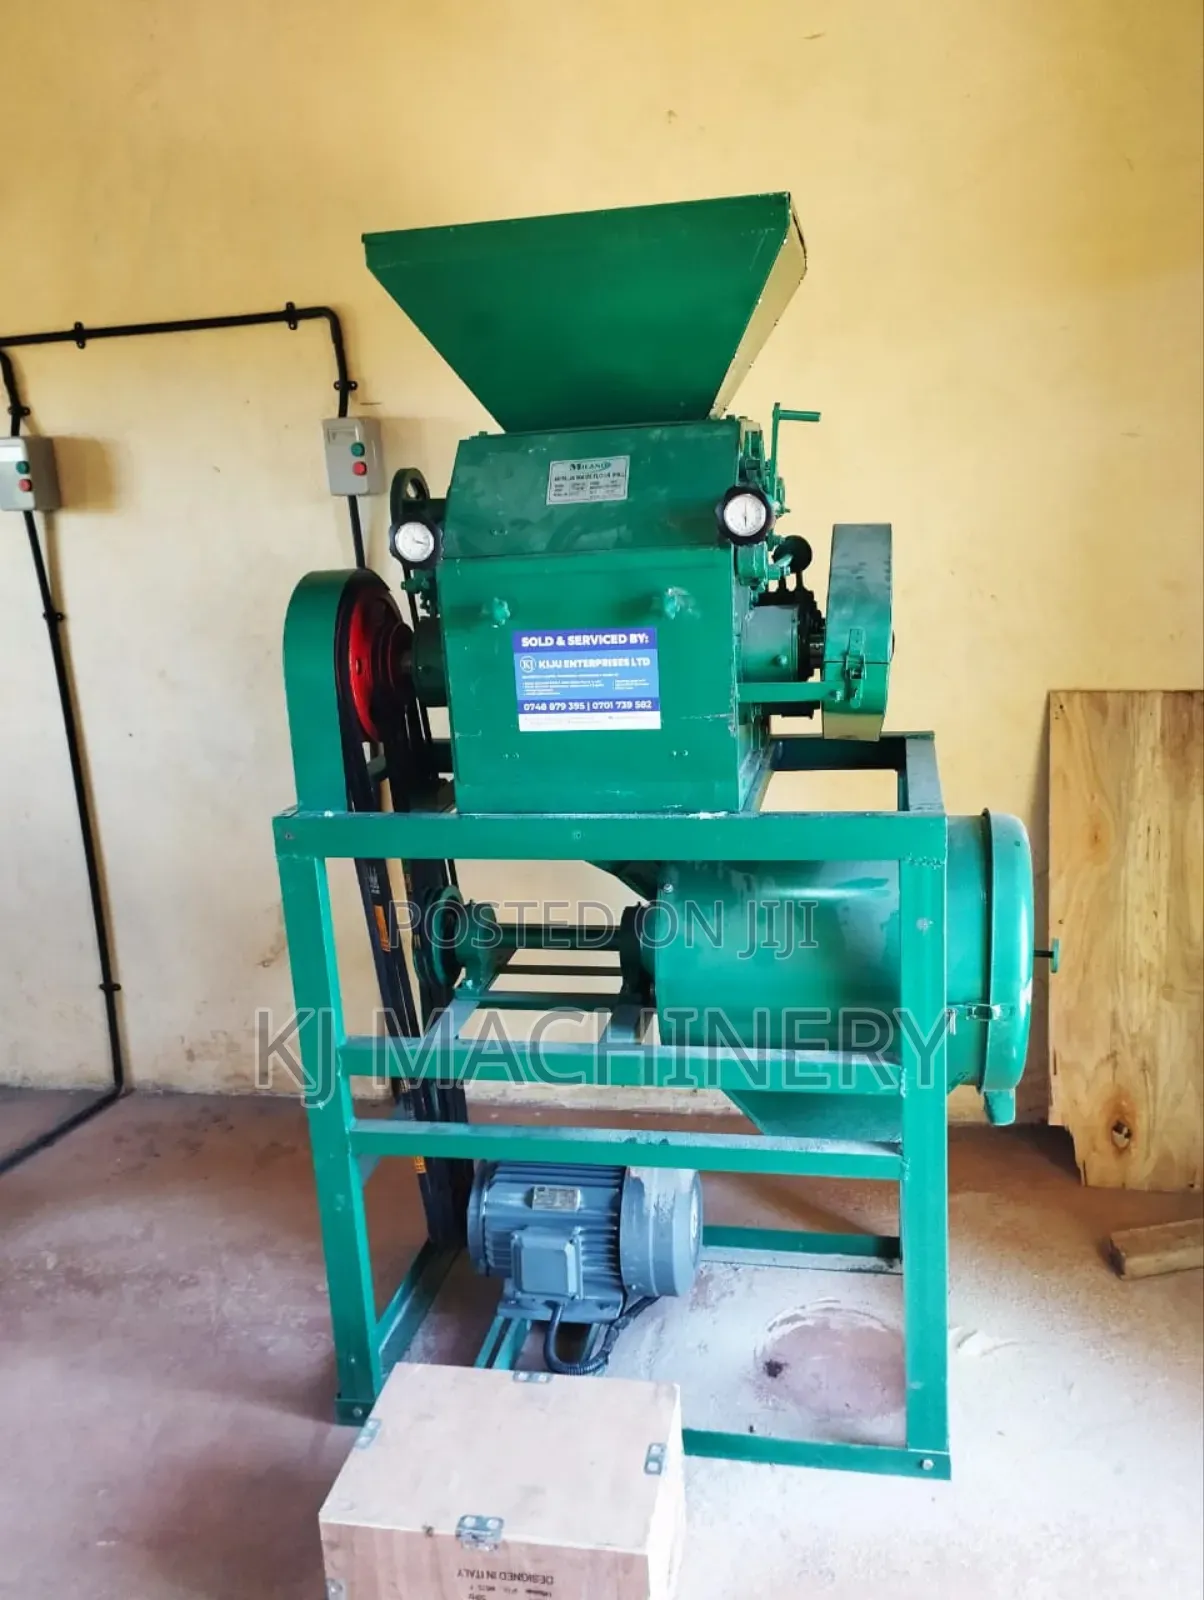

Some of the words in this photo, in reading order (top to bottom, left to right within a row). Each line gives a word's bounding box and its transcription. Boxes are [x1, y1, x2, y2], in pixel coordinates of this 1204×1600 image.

[521, 636, 553, 647] SOLD
[556, 635, 566, 646] &
[567, 633, 627, 646] SERVICED
[629, 632, 649, 644] BY:
[563, 657, 629, 669] ENTERPRISES
[630, 657, 651, 667] LTD
[592, 700, 613, 710] 0701
[457, 1568, 485, 1580] ITALY
[486, 1570, 498, 1580] IN
[499, 1571, 554, 1585] DESIGNED
